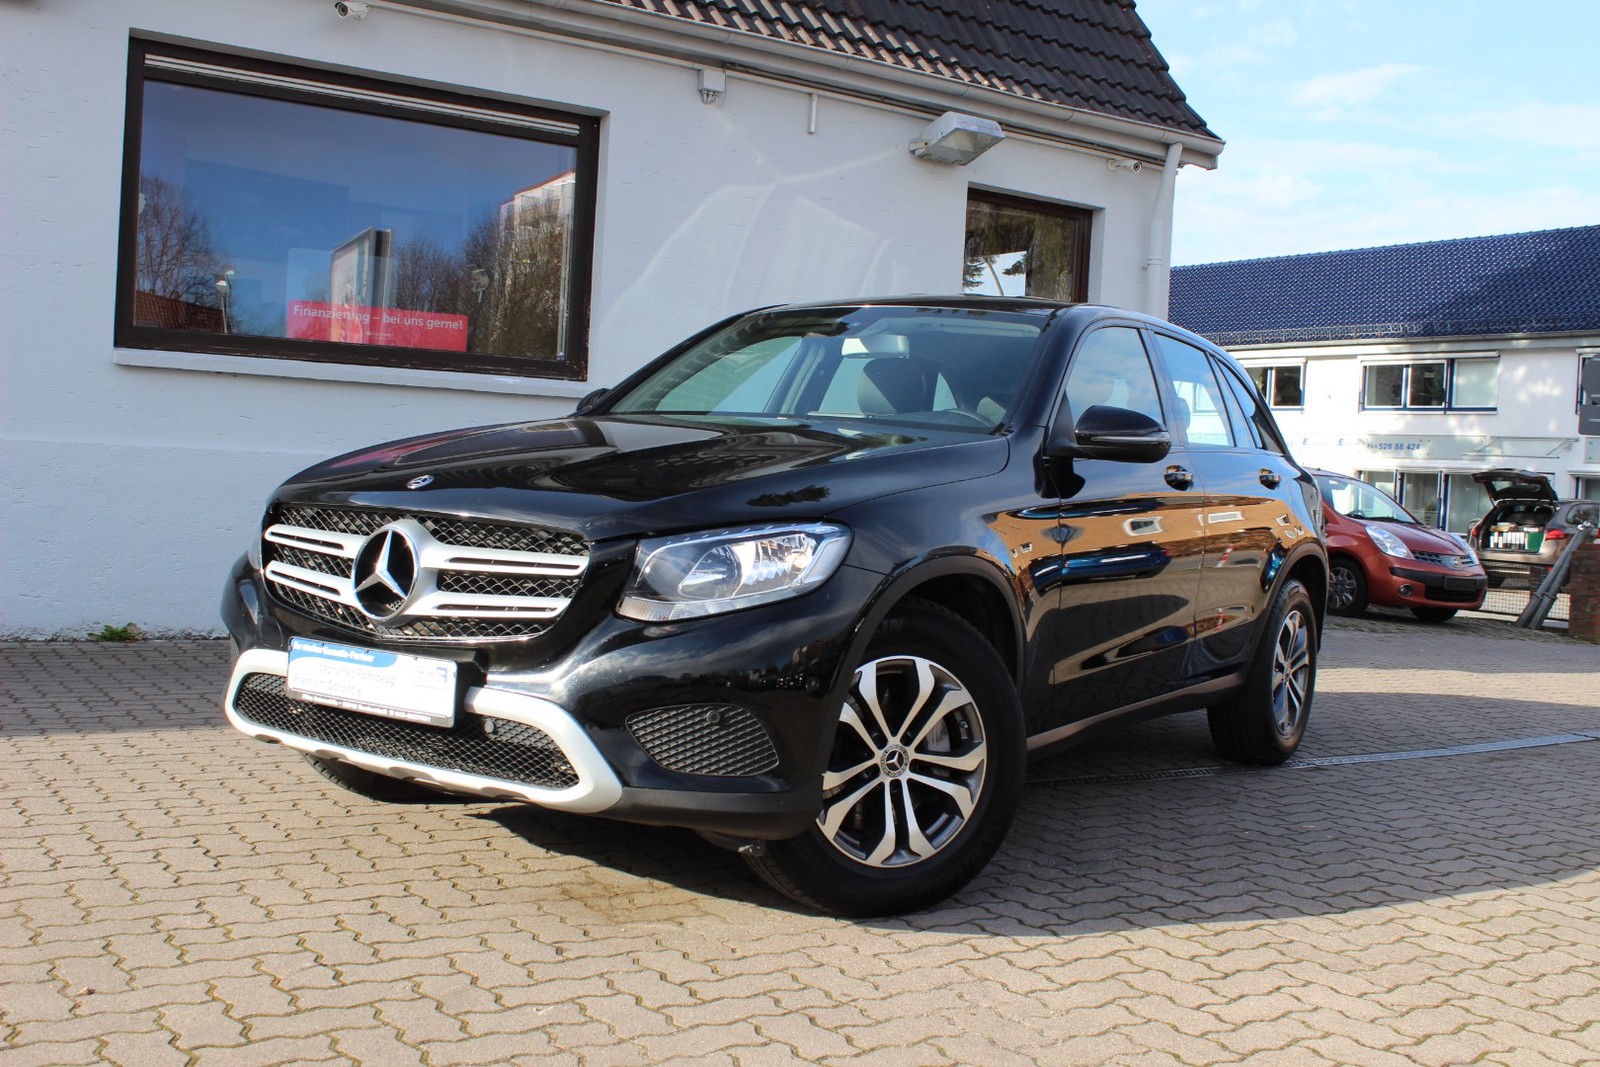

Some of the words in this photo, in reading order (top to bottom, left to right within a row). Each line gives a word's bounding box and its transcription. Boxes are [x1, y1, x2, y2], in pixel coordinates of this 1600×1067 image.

[293, 304, 370, 325] Finanzierung
[383, 314, 401, 325] bei
[404, 317, 424, 327] uns
[427, 319, 463, 330] gerne!
[1406, 443, 1420, 451] 424
